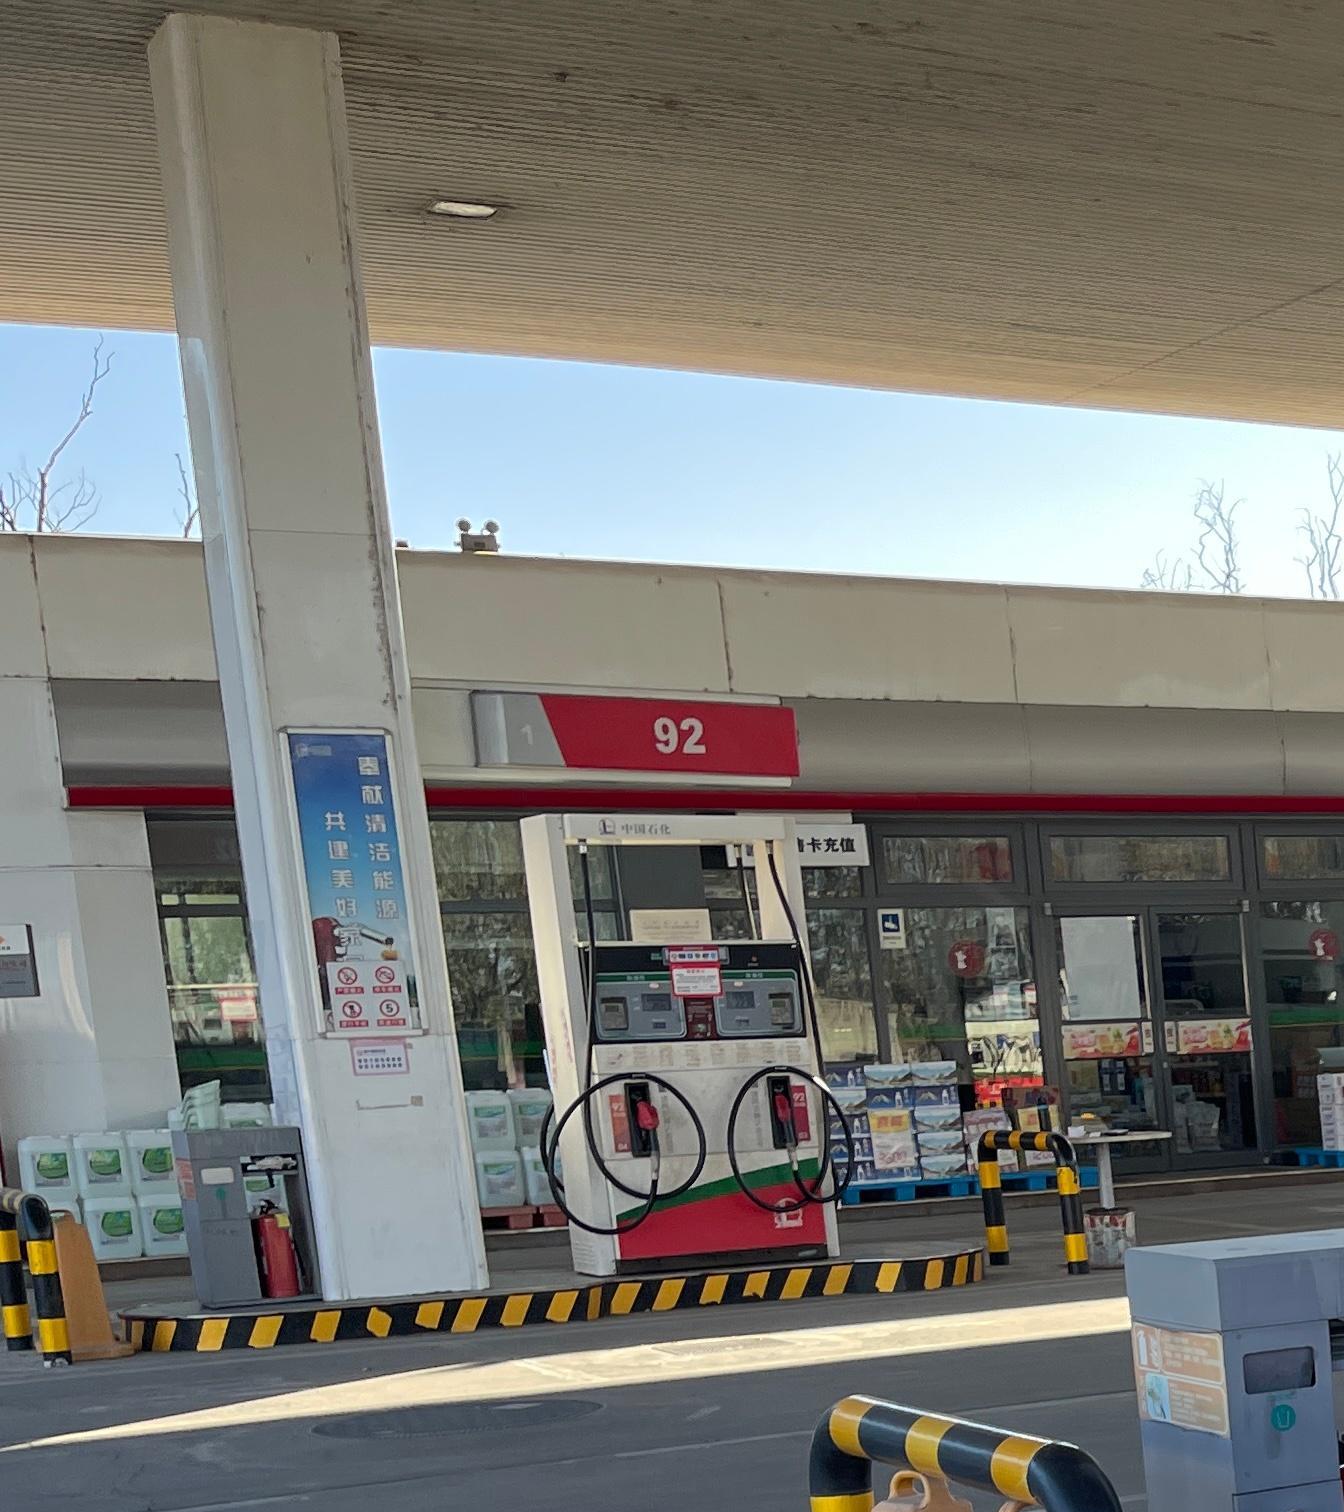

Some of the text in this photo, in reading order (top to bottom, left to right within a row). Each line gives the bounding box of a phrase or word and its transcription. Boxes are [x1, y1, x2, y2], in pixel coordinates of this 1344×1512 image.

[520, 725, 536, 746] 1
[653, 716, 707, 756] 92
[620, 822, 671, 836] 中国石化
